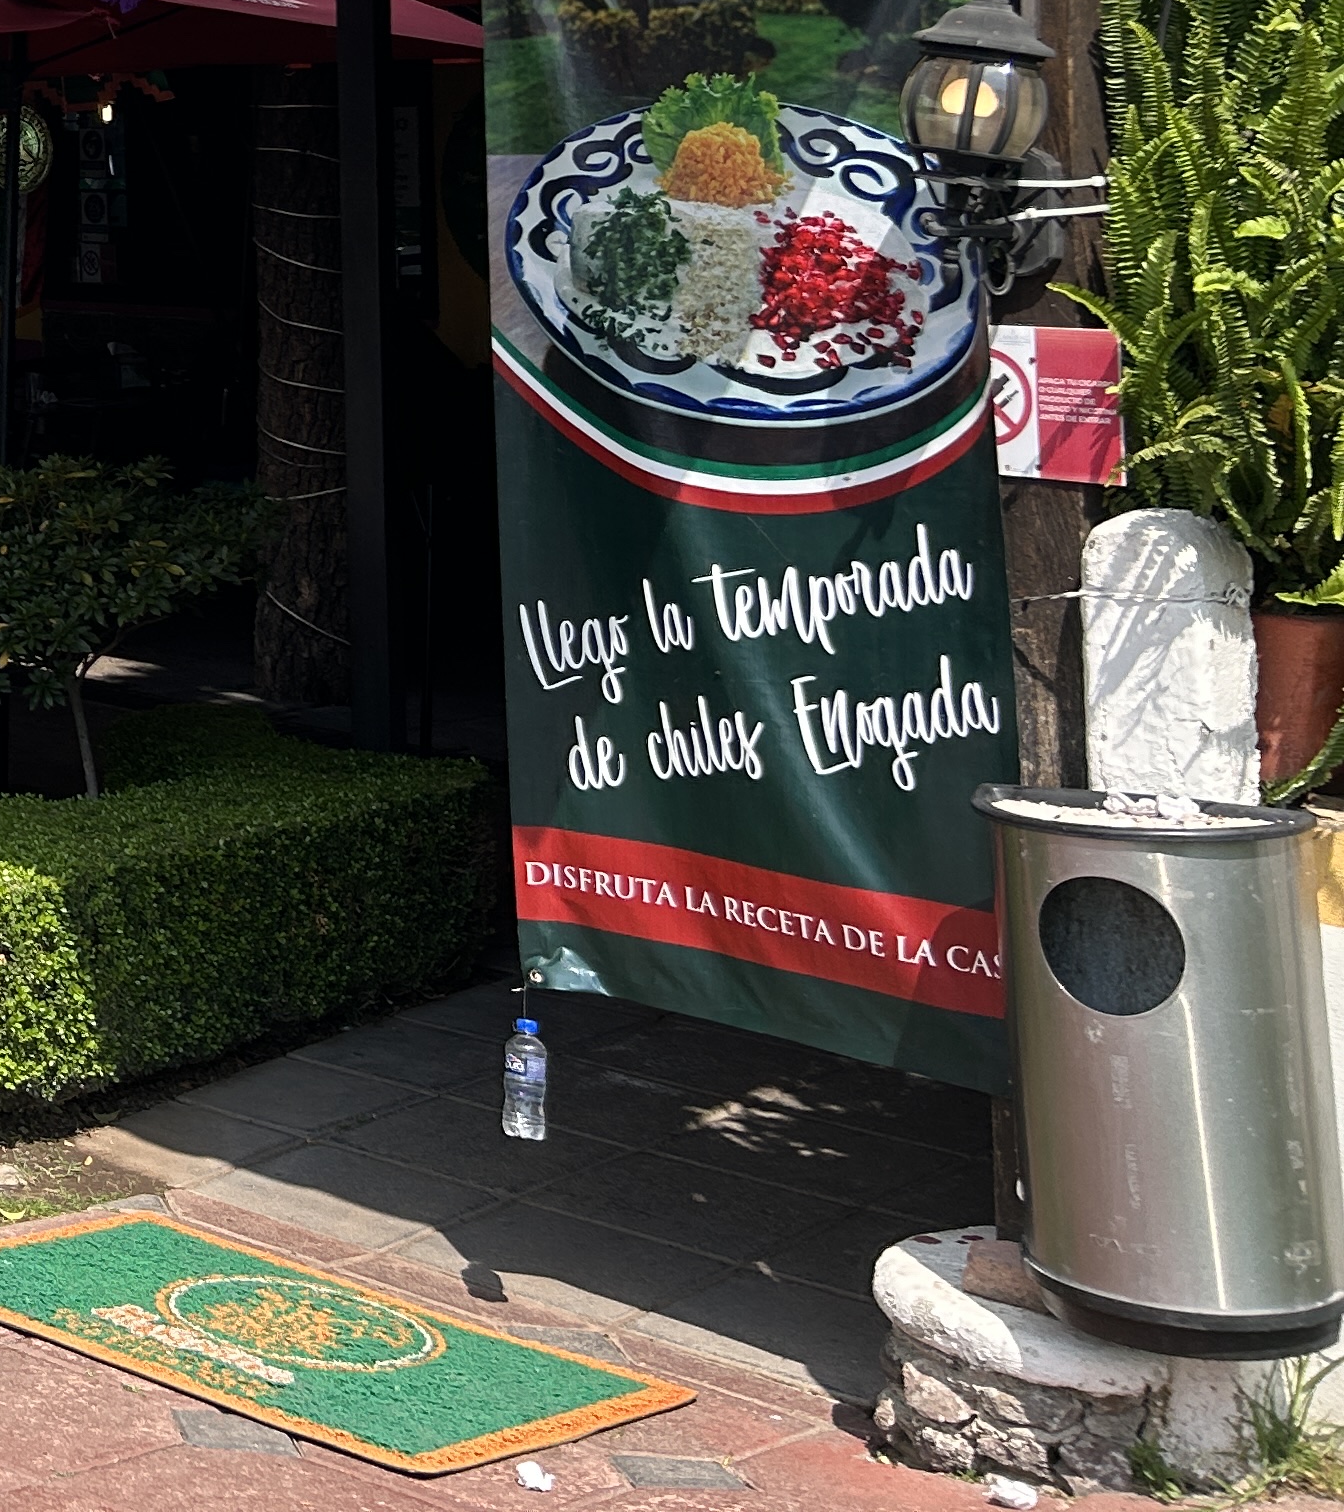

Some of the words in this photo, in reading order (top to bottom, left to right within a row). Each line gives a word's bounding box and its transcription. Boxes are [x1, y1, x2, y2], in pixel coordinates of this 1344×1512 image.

[642, 578, 695, 654] la
[568, 714, 626, 792] de
[647, 694, 765, 781] chiles
[523, 859, 677, 909] DISFRUTA
[683, 885, 719, 918] LA
[722, 895, 837, 947] RECETA
[841, 923, 887, 958] DE
[896, 934, 938, 967] LA
